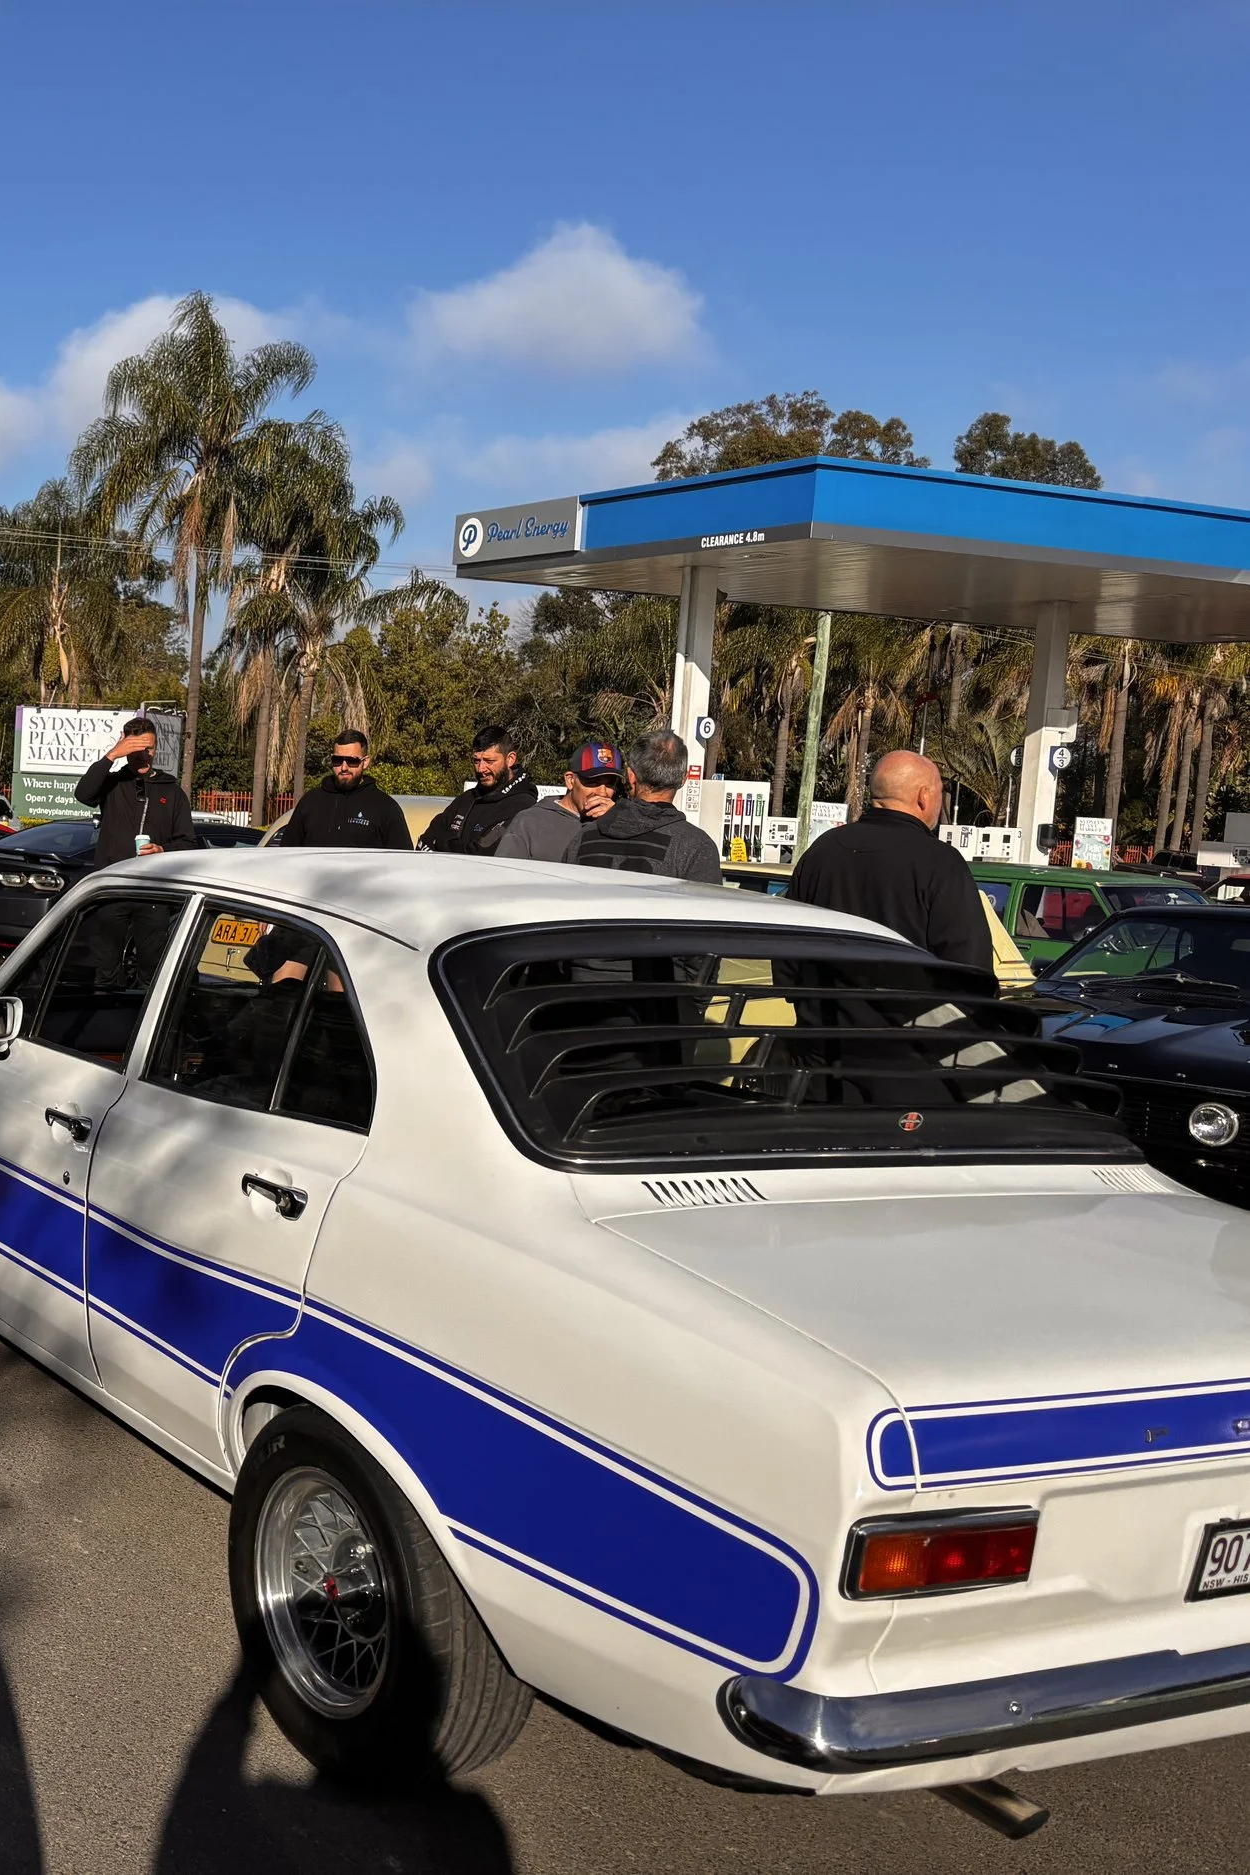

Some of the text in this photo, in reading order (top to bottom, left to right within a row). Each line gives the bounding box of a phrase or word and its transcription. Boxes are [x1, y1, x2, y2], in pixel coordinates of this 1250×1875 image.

[486, 516, 569, 542] Pearl Energy
[701, 531, 765, 549] CLEARANCE 4.8m
[29, 716, 113, 733] SYDNEY'S
[704, 721, 712, 734] 6
[29, 731, 90, 747] PLANT
[27, 746, 106, 763] MARKET
[1059, 748, 1065, 757] 4
[1059, 759, 1065, 768] 3
[22, 777, 52, 789] Where
[25, 793, 46, 803] Open
[48, 794, 54, 802] 7
[1203, 1578, 1225, 1590] NSW
[1234, 1573, 1249, 1584] HIS
